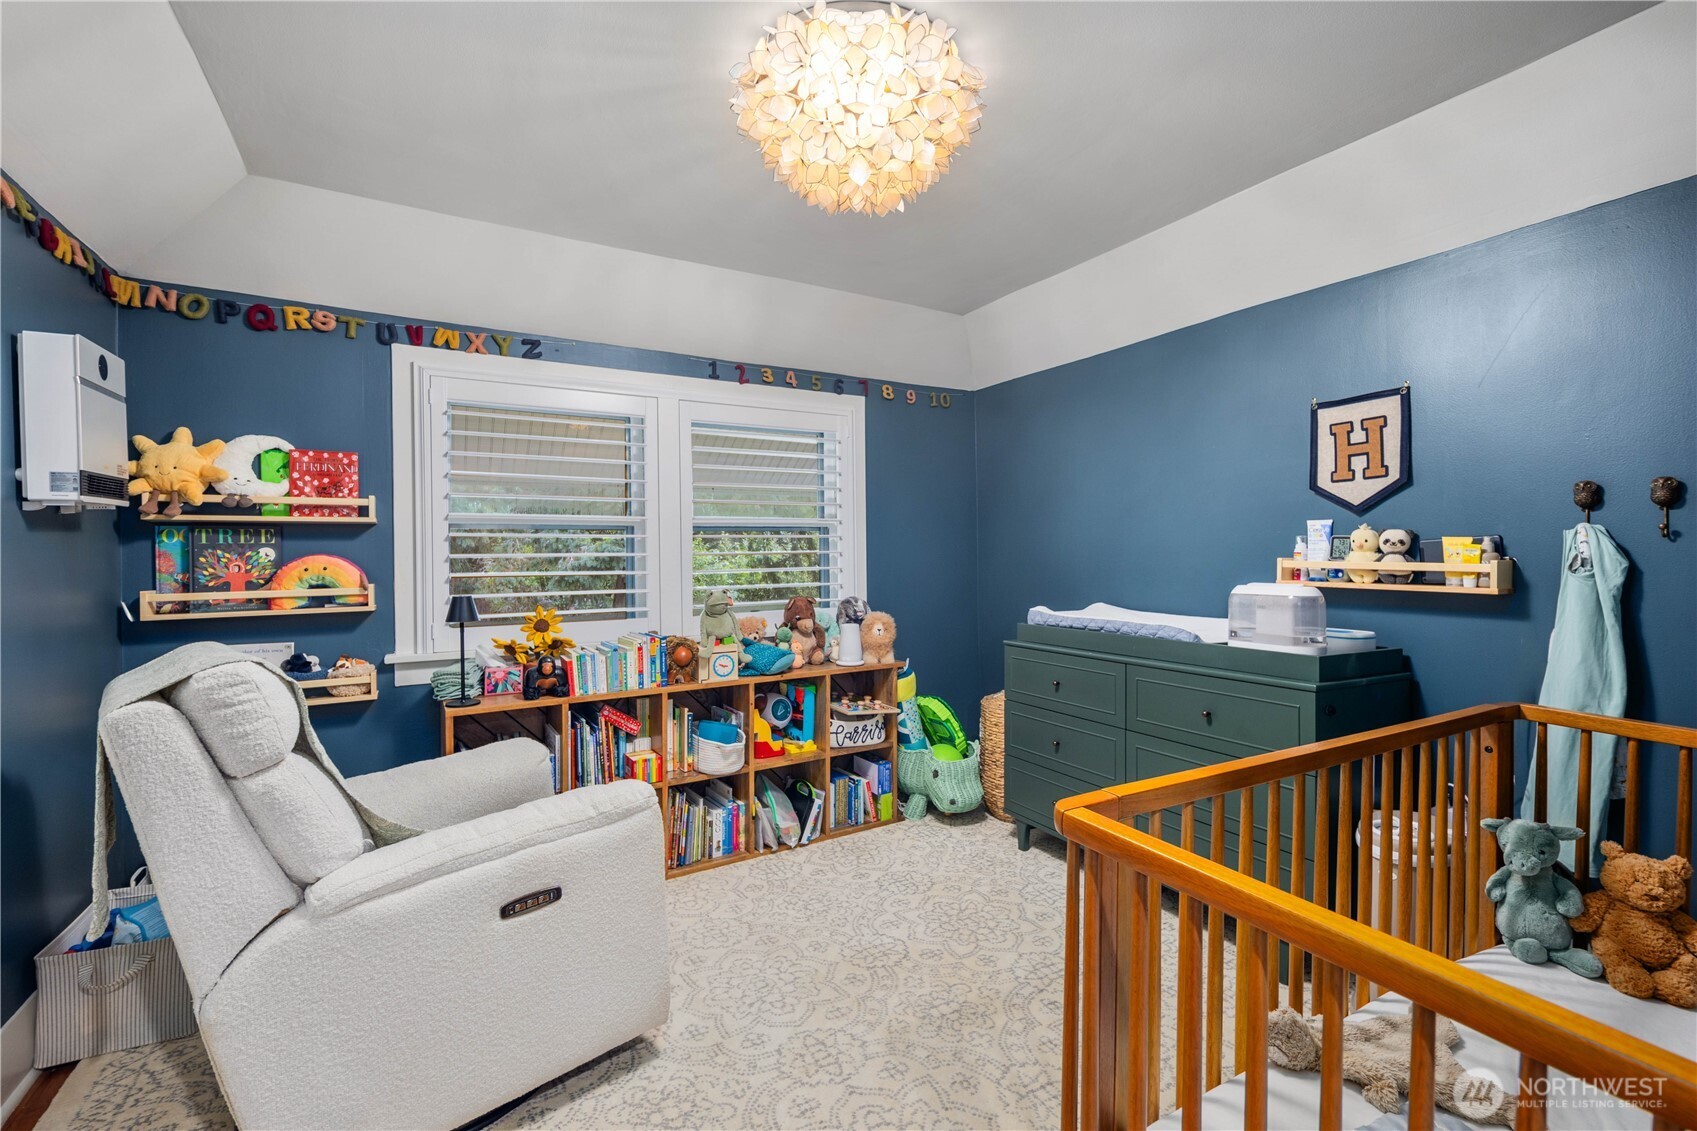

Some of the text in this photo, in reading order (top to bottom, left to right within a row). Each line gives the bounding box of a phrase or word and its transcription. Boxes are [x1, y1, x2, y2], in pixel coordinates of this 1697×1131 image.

[144, 285, 177, 312] N
[178, 293, 210, 320] O
[216, 298, 241, 324] P
[246, 303, 279, 332] Q
[282, 305, 313, 331] R
[311, 309, 337, 332] S
[337, 315, 366, 339] T
[376, 322, 398, 345] U
[405, 325, 424, 346] V
[433, 326, 460, 350] W
[465, 332, 488, 355] X
[491, 333, 514, 357] Y
[521, 338, 543, 359] Z
[708, 361, 951, 408] 1 2 3 4 5 6 7 8 9 10
[1330, 415, 1389, 483] H
[194, 528, 276, 545] TREE
